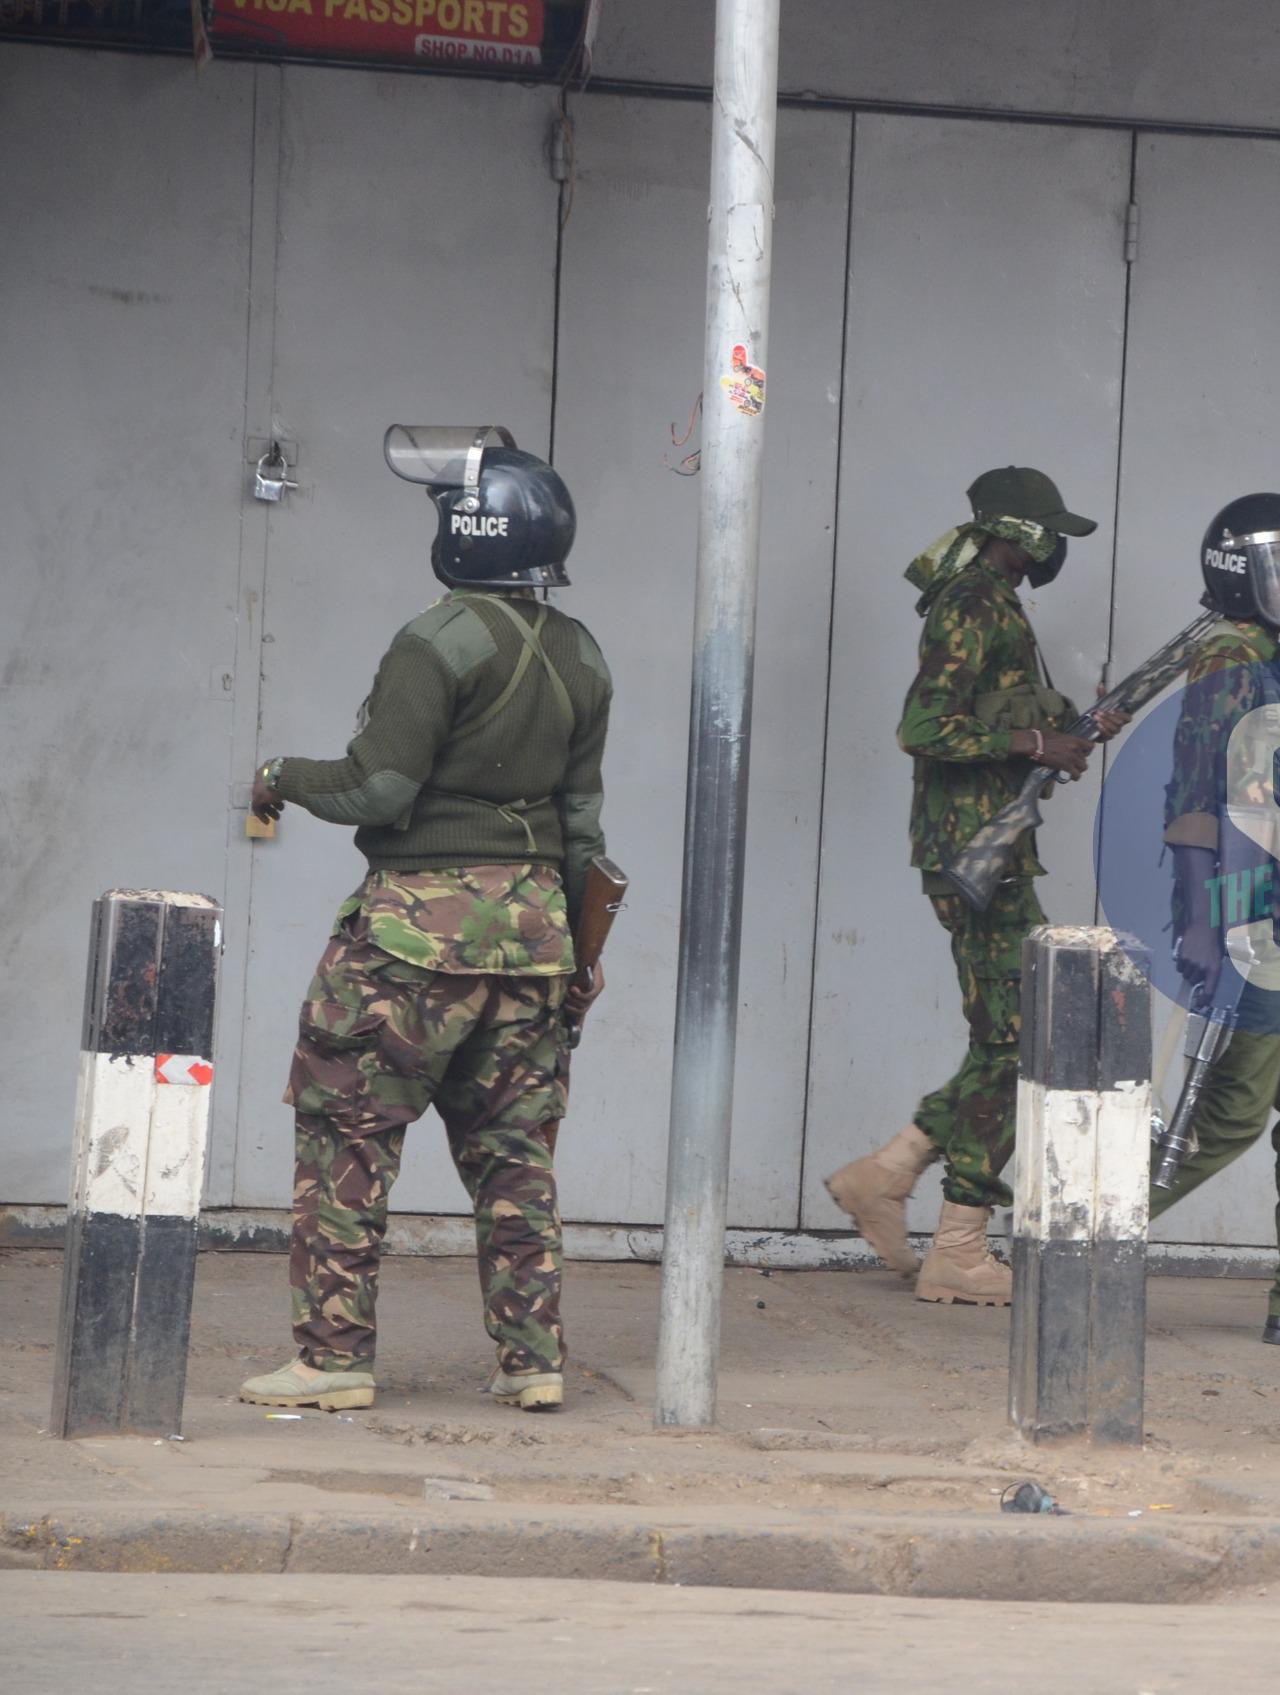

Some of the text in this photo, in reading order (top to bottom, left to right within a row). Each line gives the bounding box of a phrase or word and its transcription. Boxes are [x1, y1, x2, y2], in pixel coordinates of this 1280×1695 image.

[324, 0, 529, 38] PASSPORTS
[421, 39, 467, 60] SHOP
[451, 514, 509, 537] POLICE
[1205, 548, 1247, 575] POLICE
